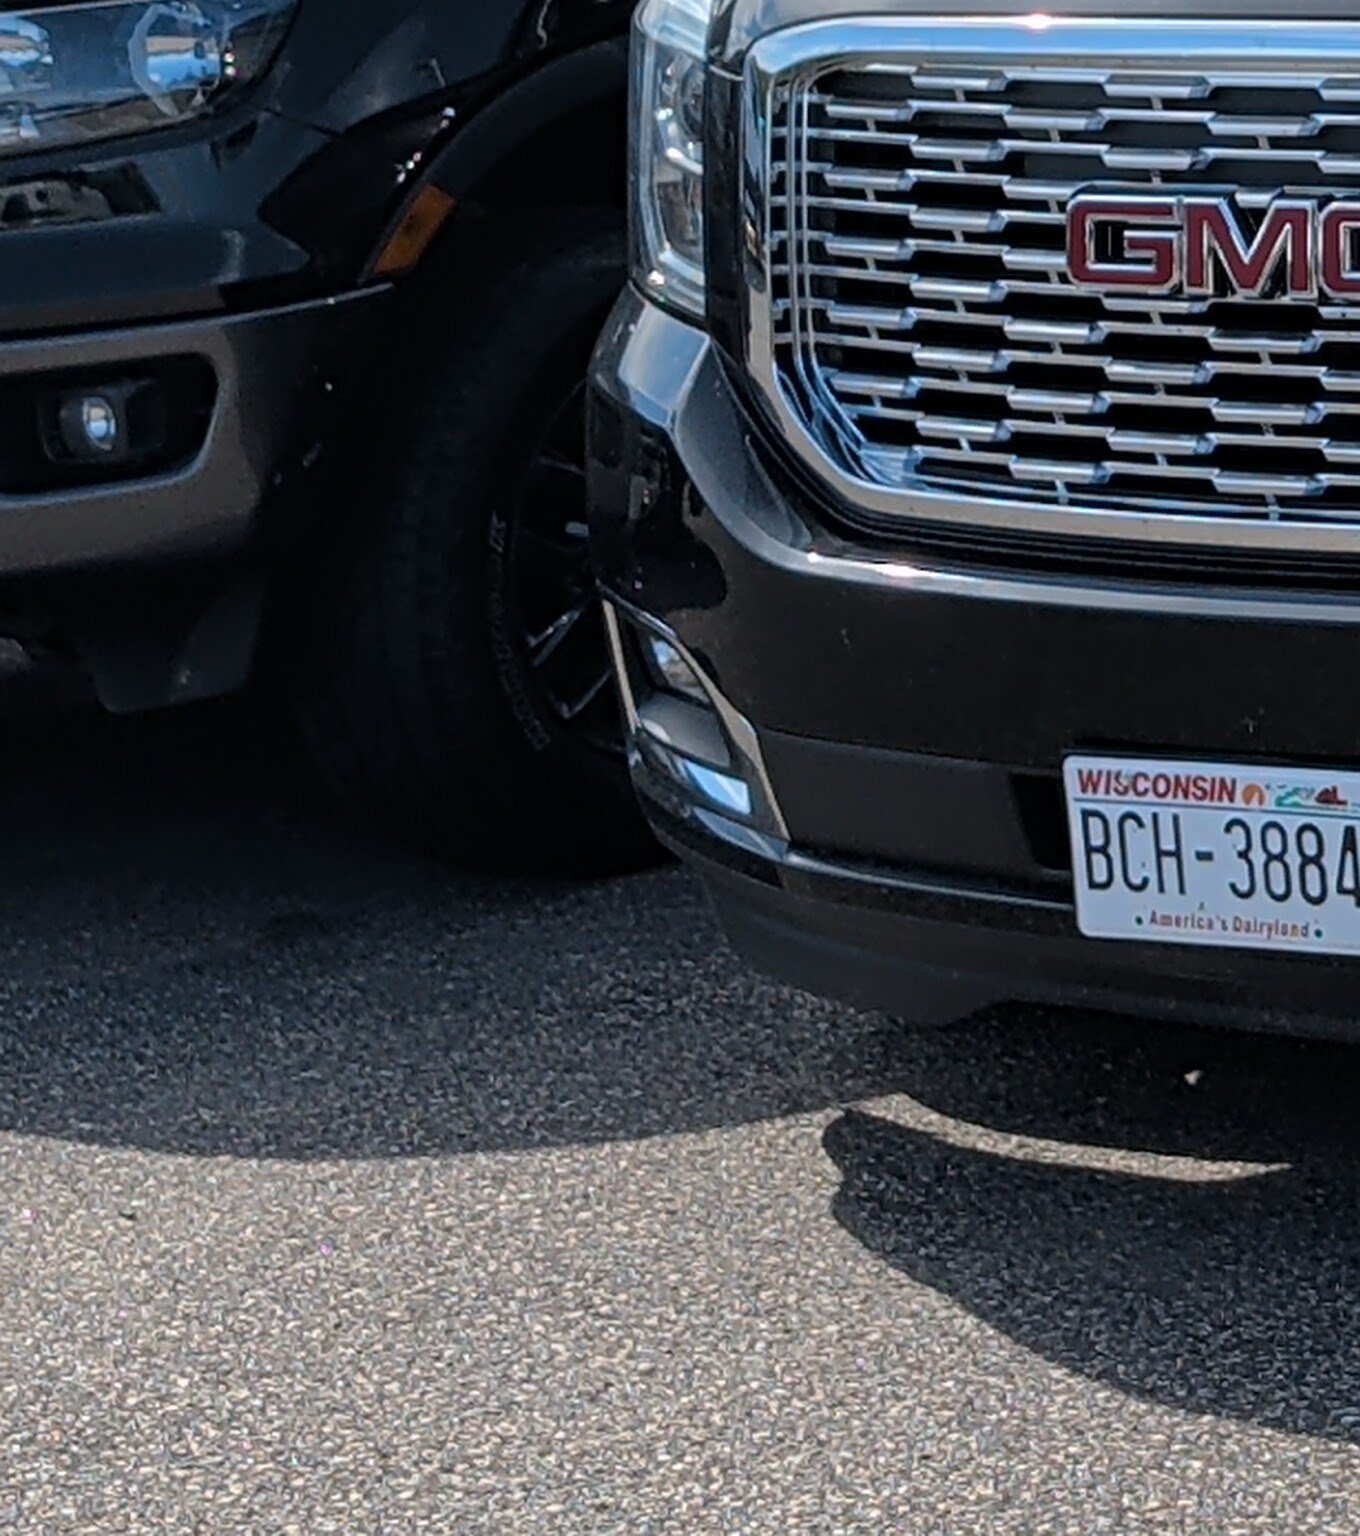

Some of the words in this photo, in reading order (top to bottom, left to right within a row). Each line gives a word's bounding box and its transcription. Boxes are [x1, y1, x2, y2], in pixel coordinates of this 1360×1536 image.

[1076, 768, 1238, 804] WISCONSIN
[1149, 910, 1229, 932] America's
[1231, 915, 1310, 940] Dairyland
